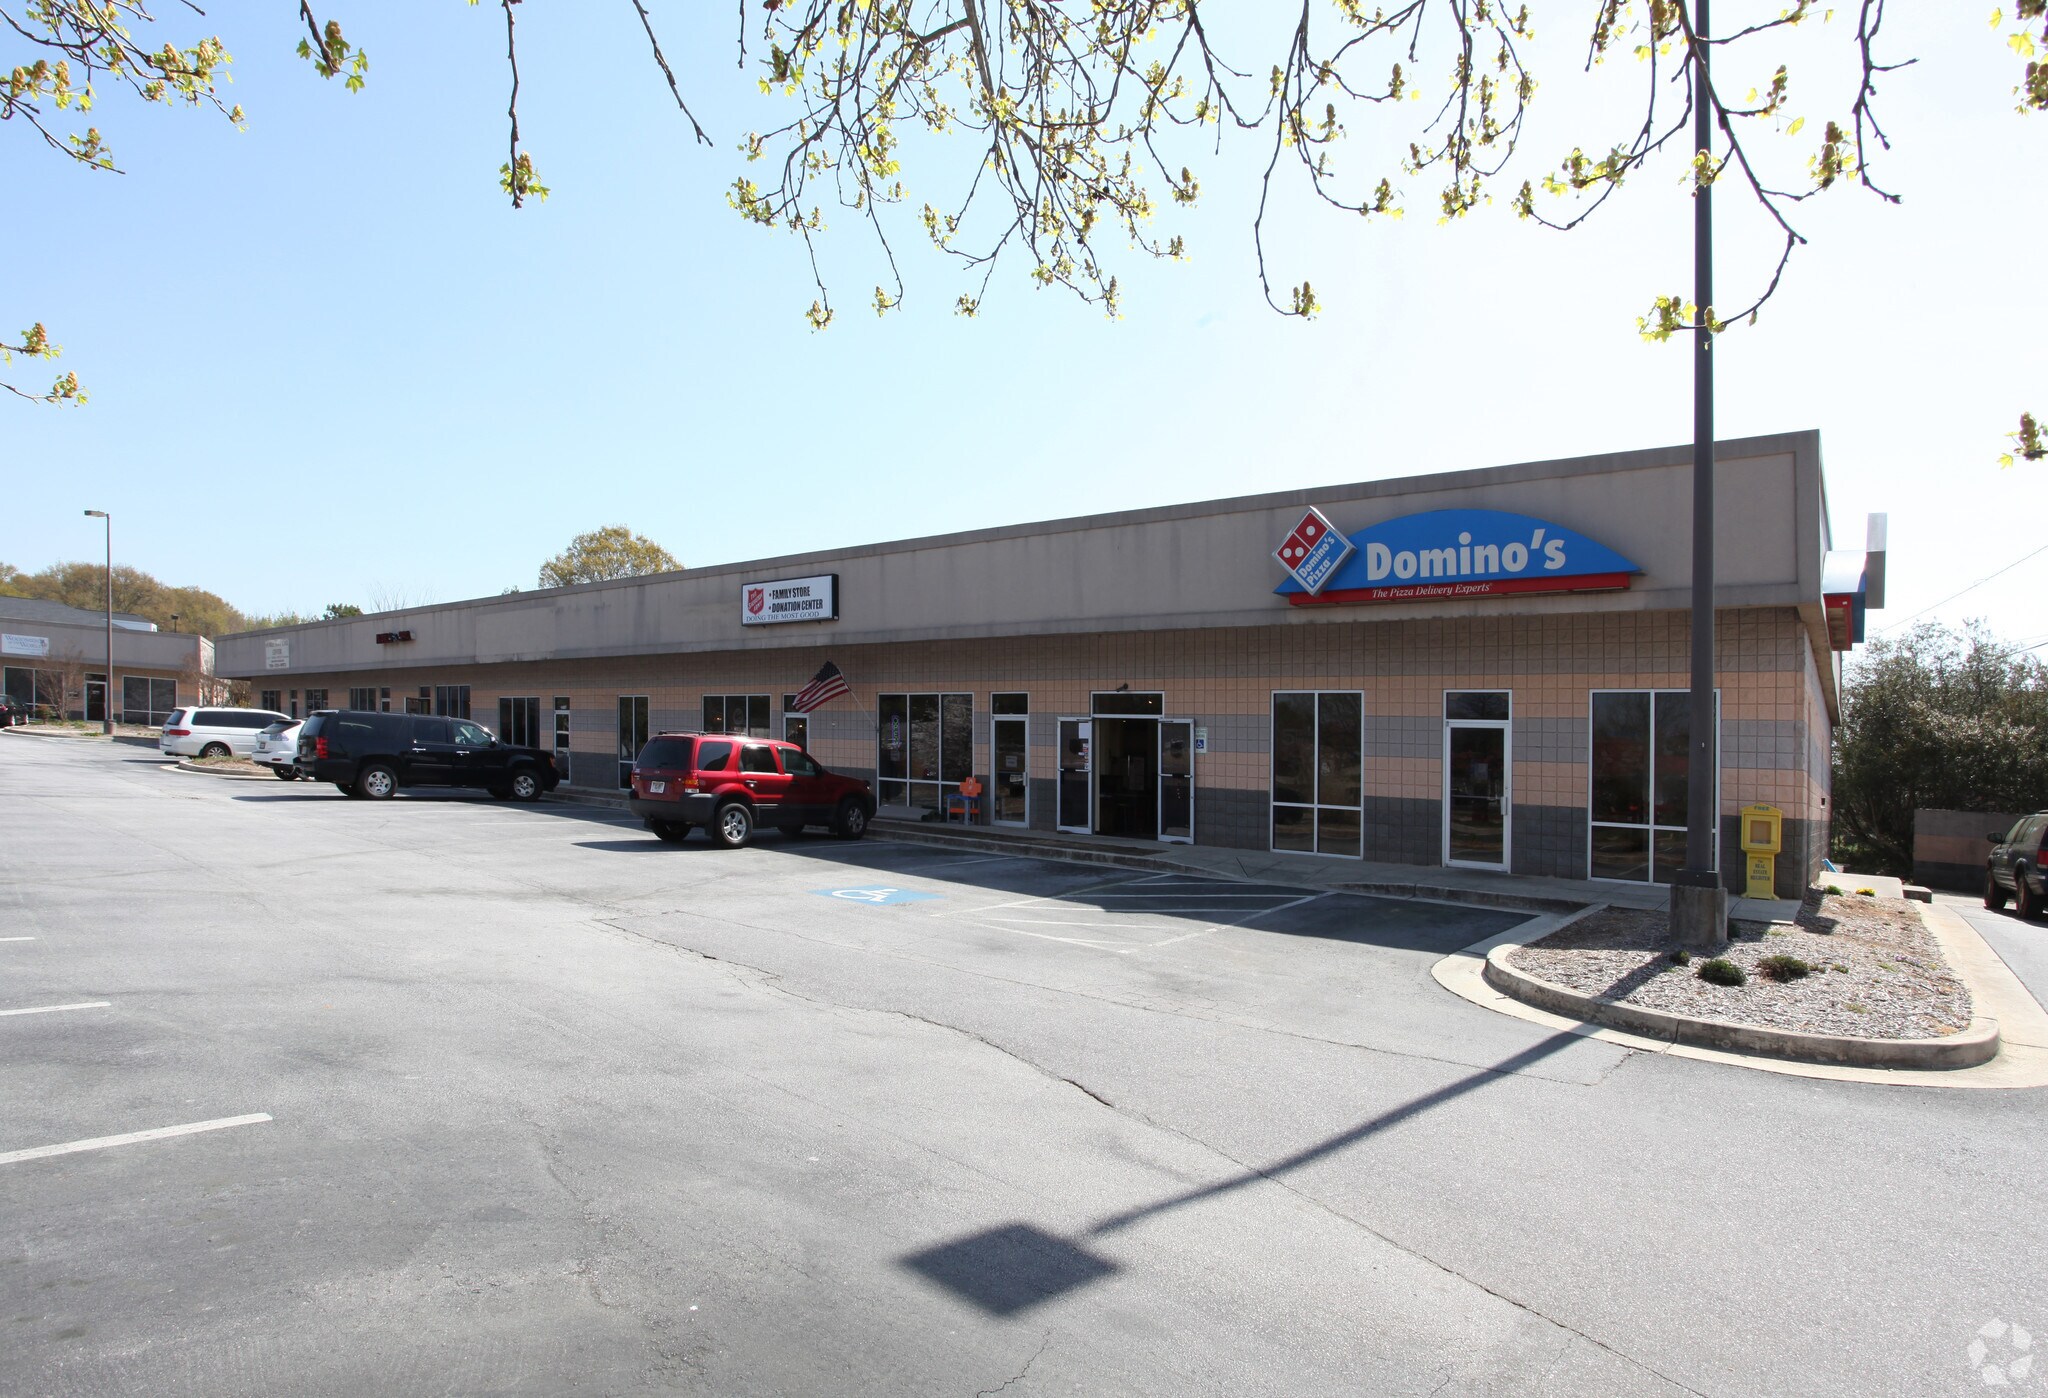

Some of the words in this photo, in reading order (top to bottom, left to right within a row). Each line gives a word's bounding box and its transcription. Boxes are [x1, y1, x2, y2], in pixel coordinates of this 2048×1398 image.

[1298, 536, 1335, 578] Domino's
[1367, 528, 1567, 581] Domino's
[1306, 558, 1331, 586] Pizza
[772, 588, 792, 600] FAMILY
[792, 586, 811, 598] STORE
[1372, 589, 1388, 598] The
[1389, 587, 1414, 597] Pizza
[1415, 585, 1453, 595] Delivery
[772, 601, 801, 613] DONATION
[801, 599, 823, 611] CENTER
